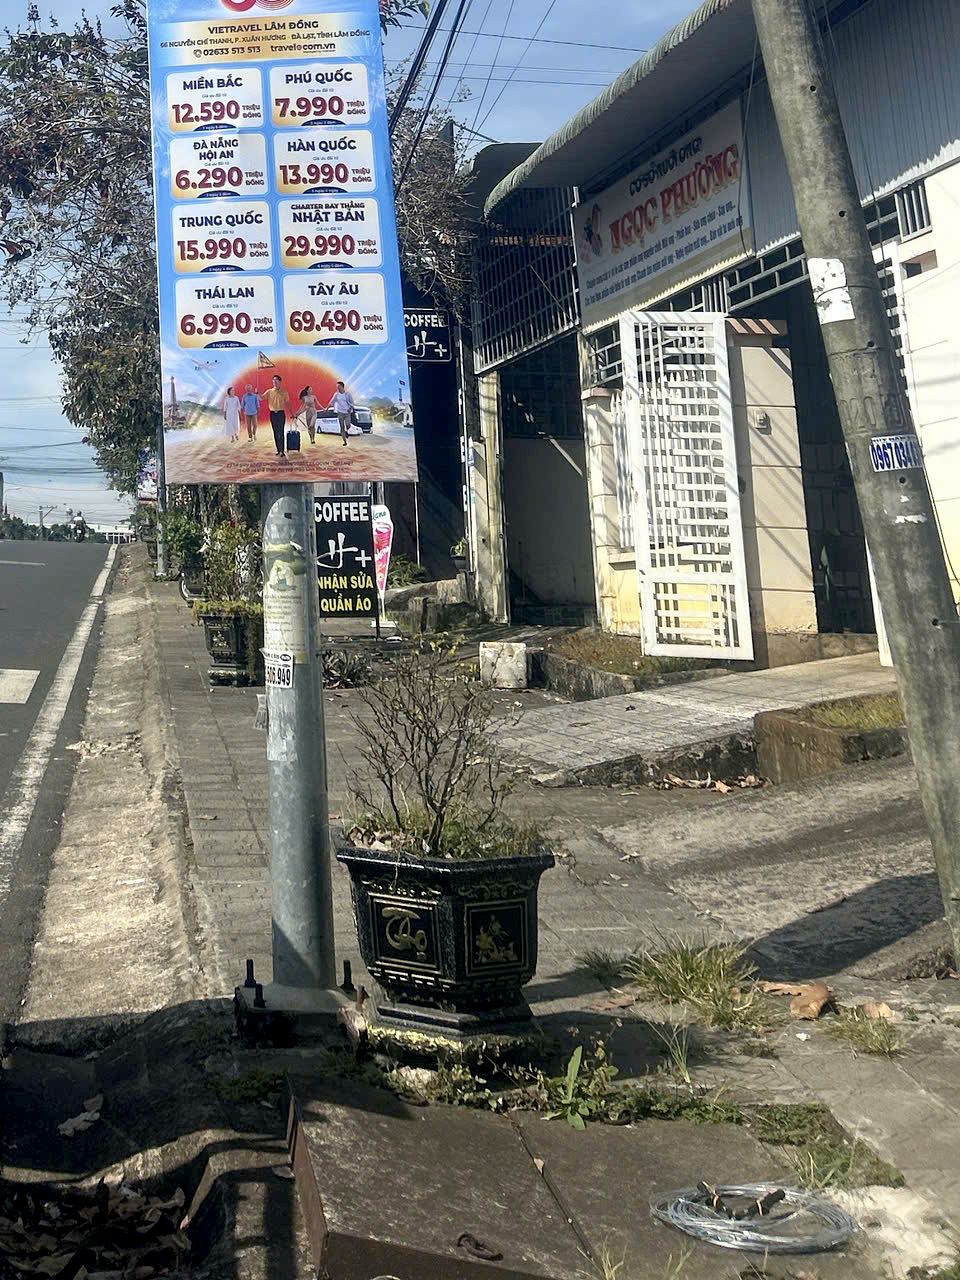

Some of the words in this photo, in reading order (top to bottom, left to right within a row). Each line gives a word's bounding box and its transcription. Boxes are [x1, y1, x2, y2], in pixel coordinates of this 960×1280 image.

[208, 24, 262, 34] VIETRAVEL
[264, 22, 286, 31] LÂM
[288, 19, 319, 29] ĐỒNG
[183, 76, 213, 90] MIỀN
[217, 73, 243, 88] BẮC
[285, 71, 312, 84] PHÚ
[315, 68, 353, 84] QUỐC
[172, 100, 240, 123] 12.590
[275, 96, 344, 117] 7.990
[193, 140, 208, 150] ĐÀ
[210, 137, 238, 148] NẴNG
[288, 139, 315, 152] HÀN
[319, 136, 357, 152] QUỐC
[199, 150, 217, 161] HỘI
[219, 150, 234, 159] AN
[175, 166, 243, 190] 6.290
[279, 163, 349, 185] 13.990
[179, 215, 222, 227] TRUNG
[225, 210, 263, 227] QUỐC
[292, 210, 331, 224] NHẬT
[334, 208, 365, 221] BẢN
[609, 196, 658, 254] NGỌC
[177, 237, 246, 261] 15.990
[284, 234, 355, 256] 29.990
[195, 286, 225, 299] THÁI
[229, 287, 254, 298] LAN
[308, 282, 335, 296] TÂY
[339, 282, 359, 295] ÂU
[180, 312, 251, 336] 6.990
[290, 310, 361, 332] 69.490
[403, 313, 445, 328] COFFEE
[314, 501, 370, 523] COFFEE
[318, 573, 348, 593] NHẬN
[350, 570, 374, 590] SỬA
[321, 594, 353, 613] QUẦN
[355, 594, 372, 612] ÁO
